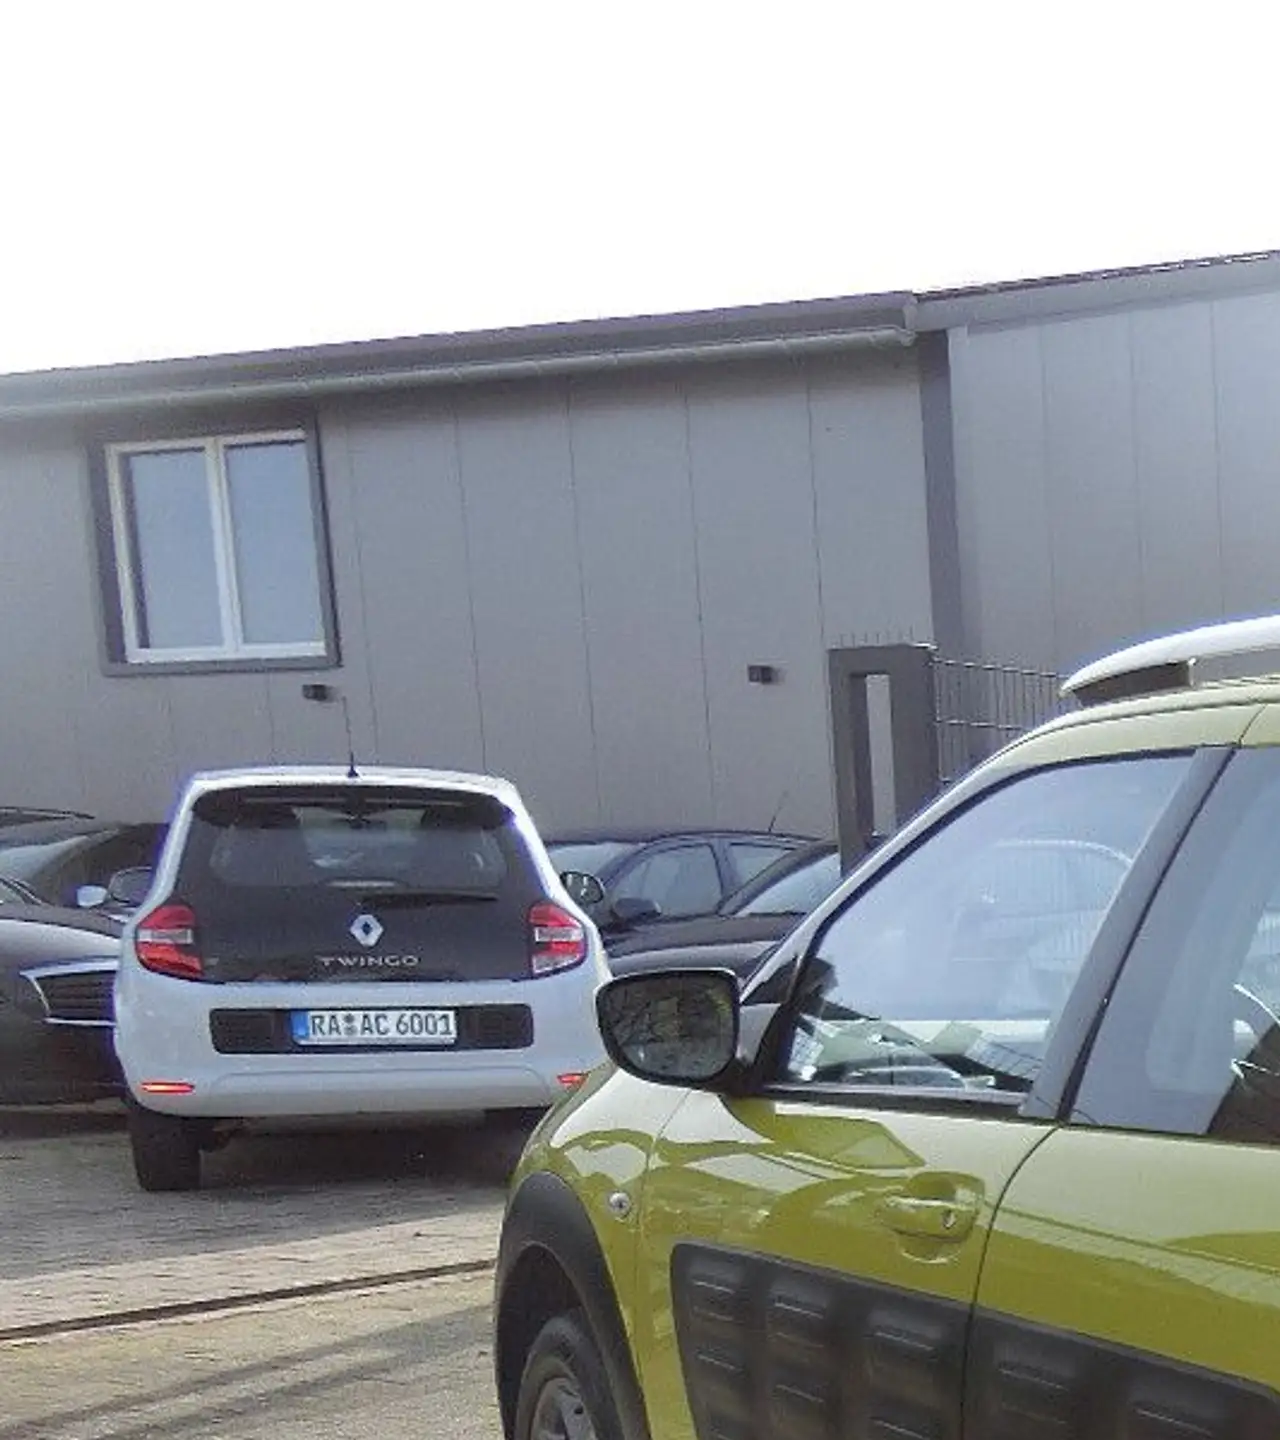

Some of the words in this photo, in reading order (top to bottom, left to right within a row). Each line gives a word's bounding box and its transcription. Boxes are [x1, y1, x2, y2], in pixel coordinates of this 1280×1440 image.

[321, 956, 418, 967] TWINGO
[311, 1015, 342, 1036] RA
[360, 1014, 393, 1036] AC
[395, 1013, 453, 1036] 6001
